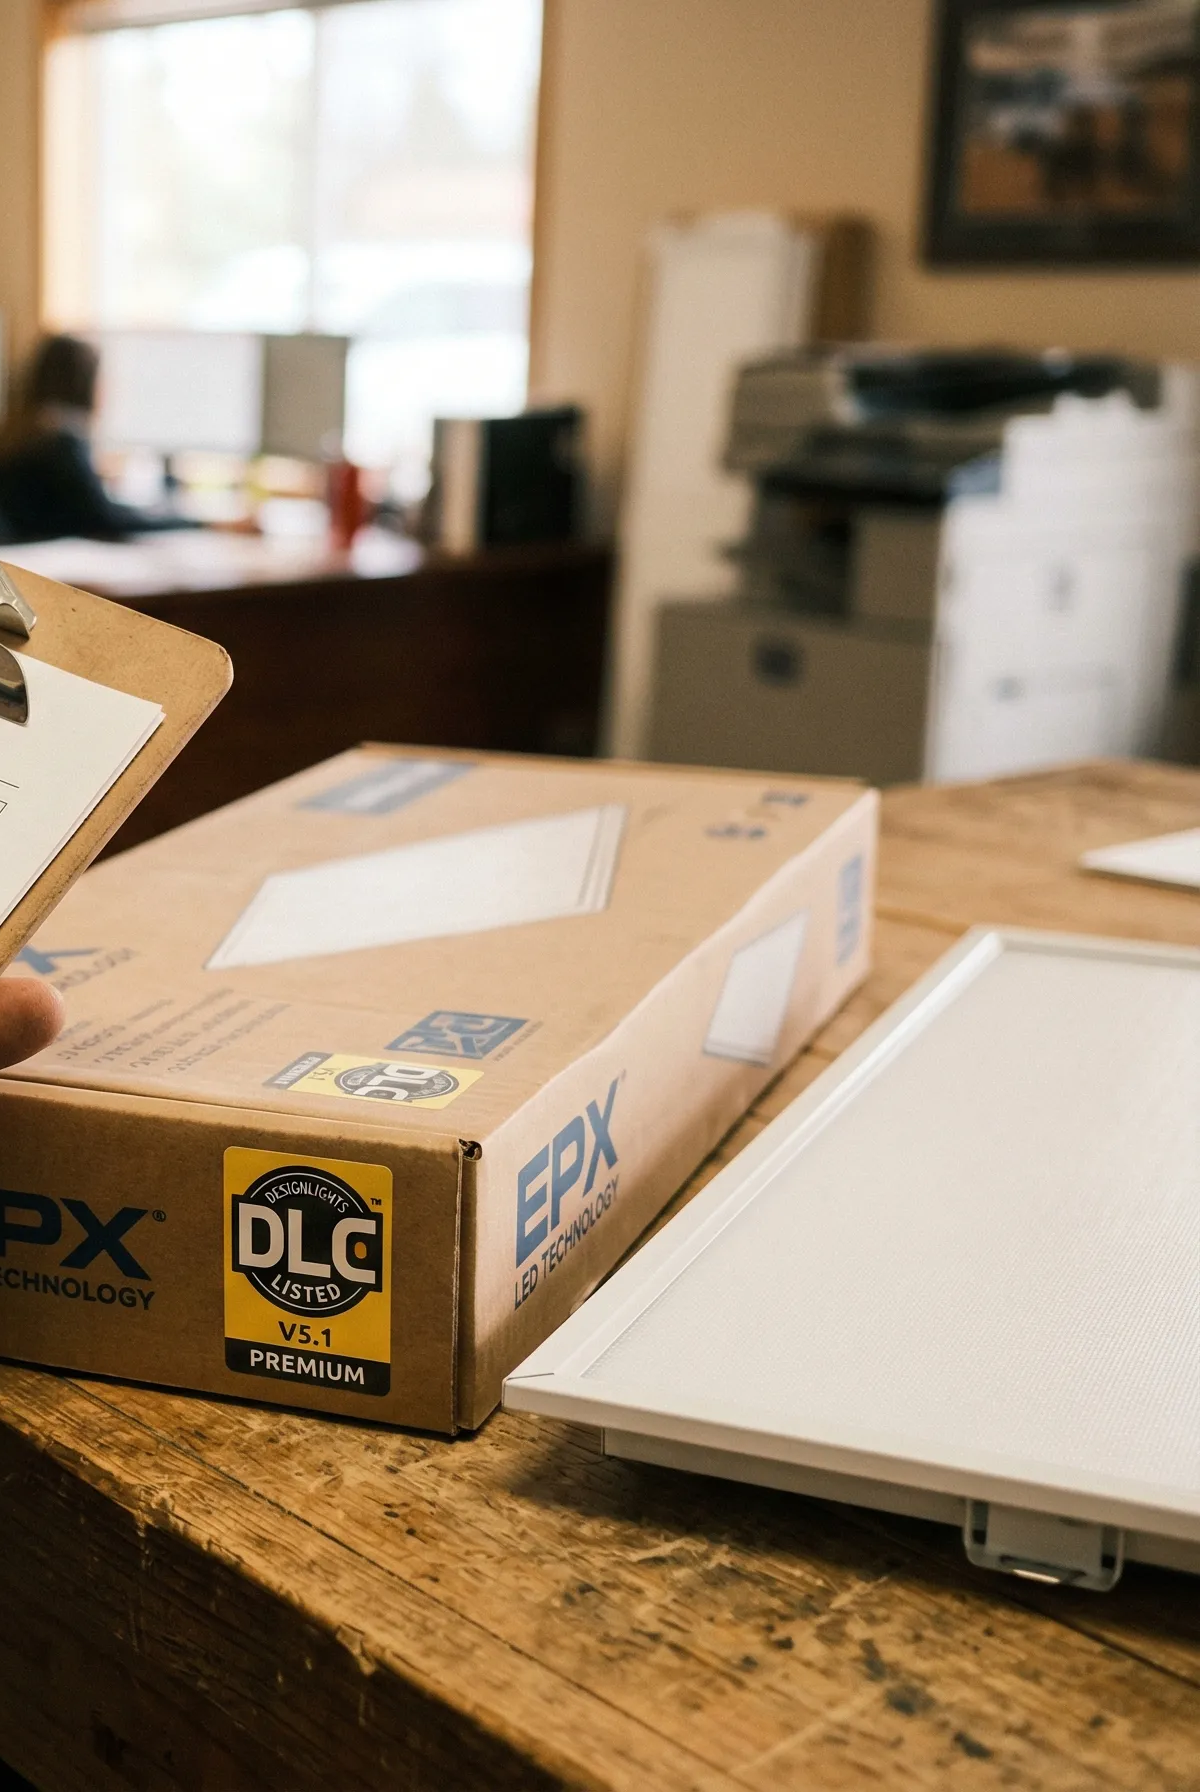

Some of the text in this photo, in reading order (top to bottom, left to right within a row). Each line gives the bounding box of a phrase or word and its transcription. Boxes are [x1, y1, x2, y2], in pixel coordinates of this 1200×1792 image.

[516, 1076, 619, 1269] EPX
[264, 1181, 349, 1214] DESIGNLIGHTS
[238, 1202, 377, 1285] DLC
[514, 1174, 620, 1312] LED TECHNOLOGY
[270, 1273, 341, 1303] LISTED
[278, 1320, 331, 1348] V5.1
[250, 1349, 365, 1385] PREMIUM
